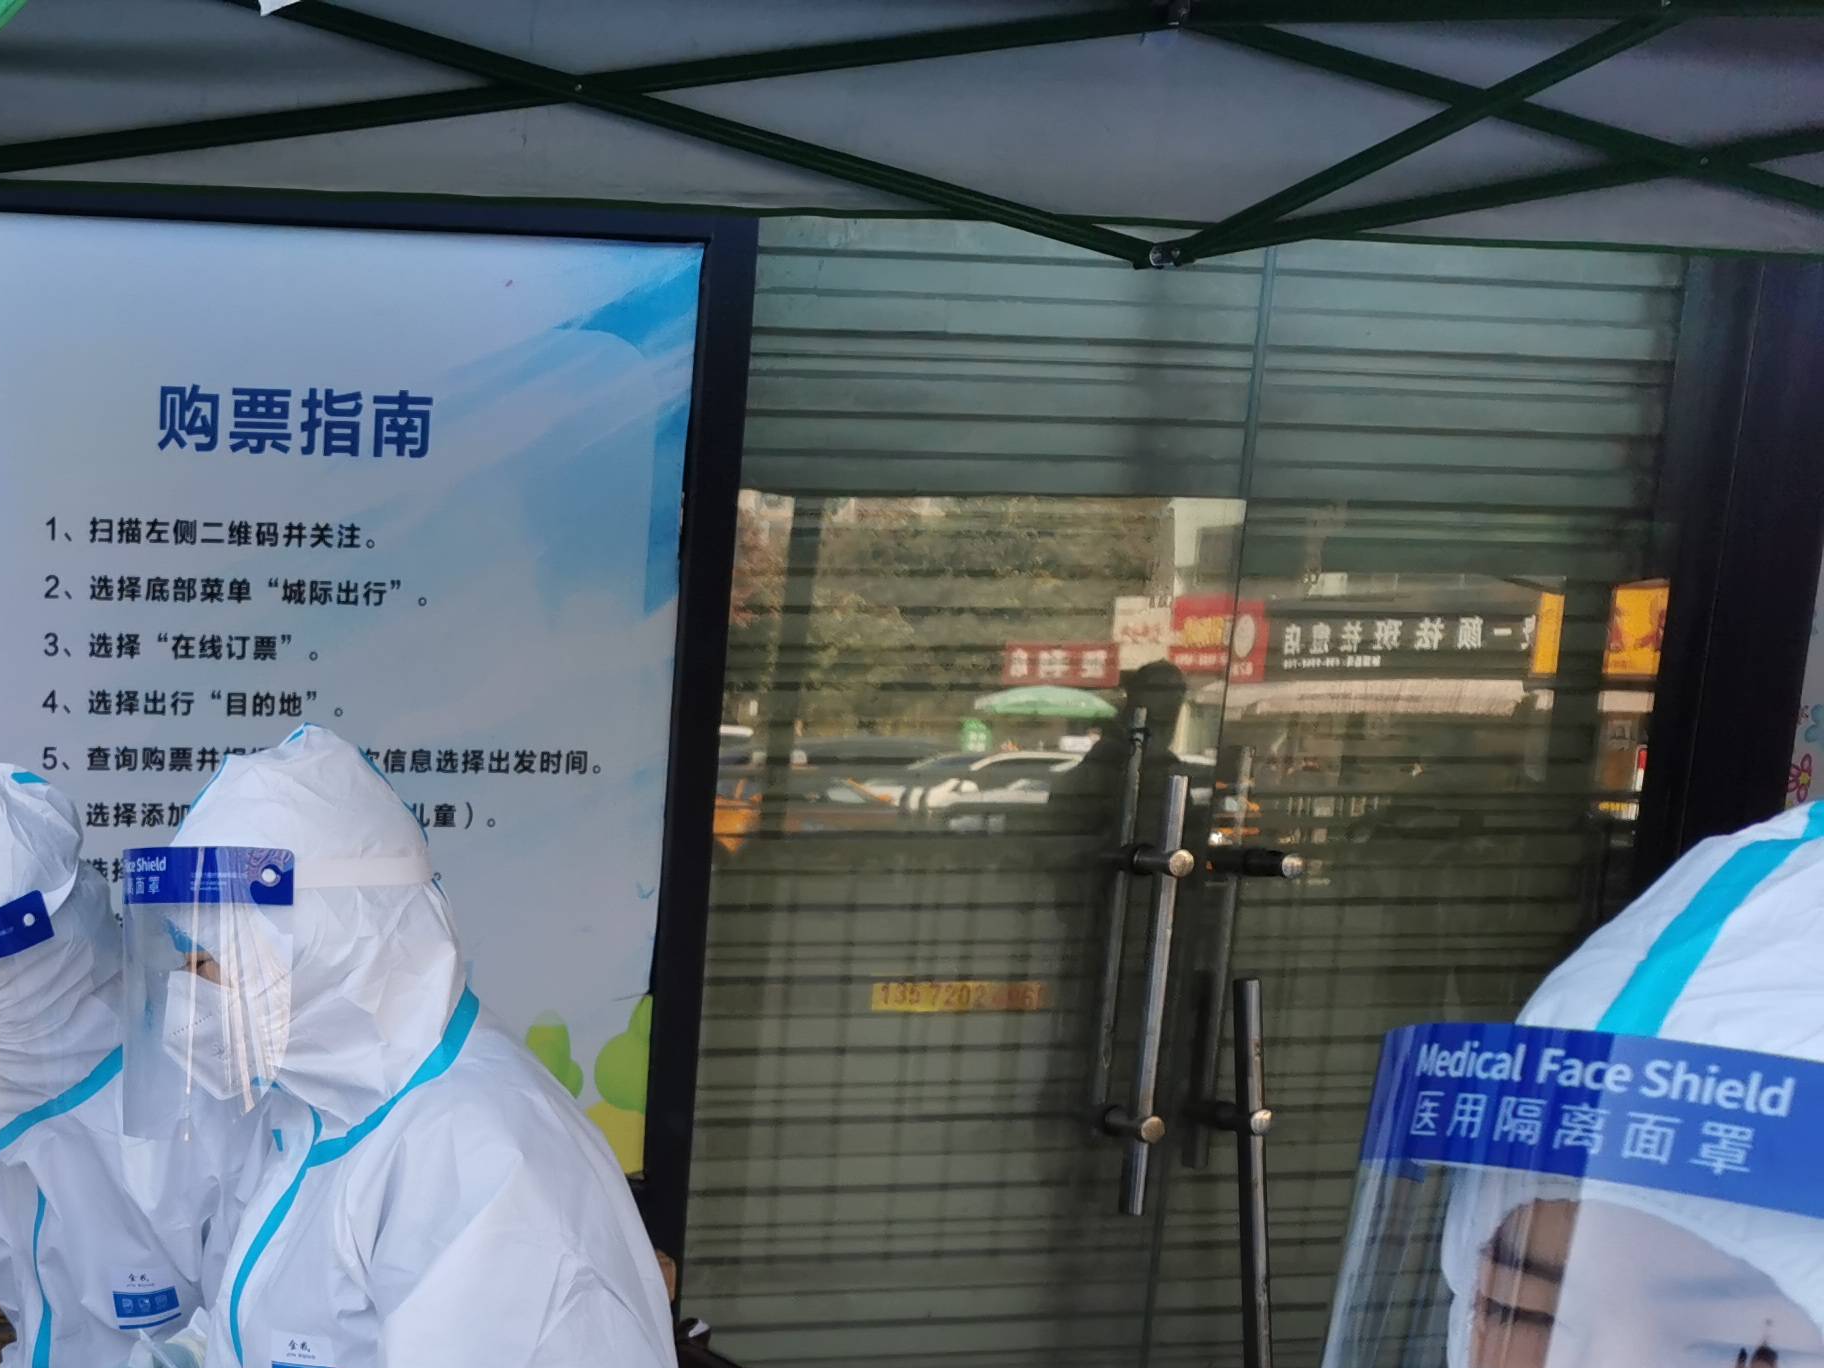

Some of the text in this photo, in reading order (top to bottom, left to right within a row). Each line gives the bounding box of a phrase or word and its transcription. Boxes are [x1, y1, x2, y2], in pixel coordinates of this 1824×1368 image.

[156, 382, 436, 460] 购票指南
[45, 516, 377, 551] 1、扫描左侧二维码并关注。
[136, 856, 167, 872] Shield
[1415, 1041, 1797, 1118] Medical Face Shield
[1409, 1090, 1756, 1176] 医用隔离面罩
